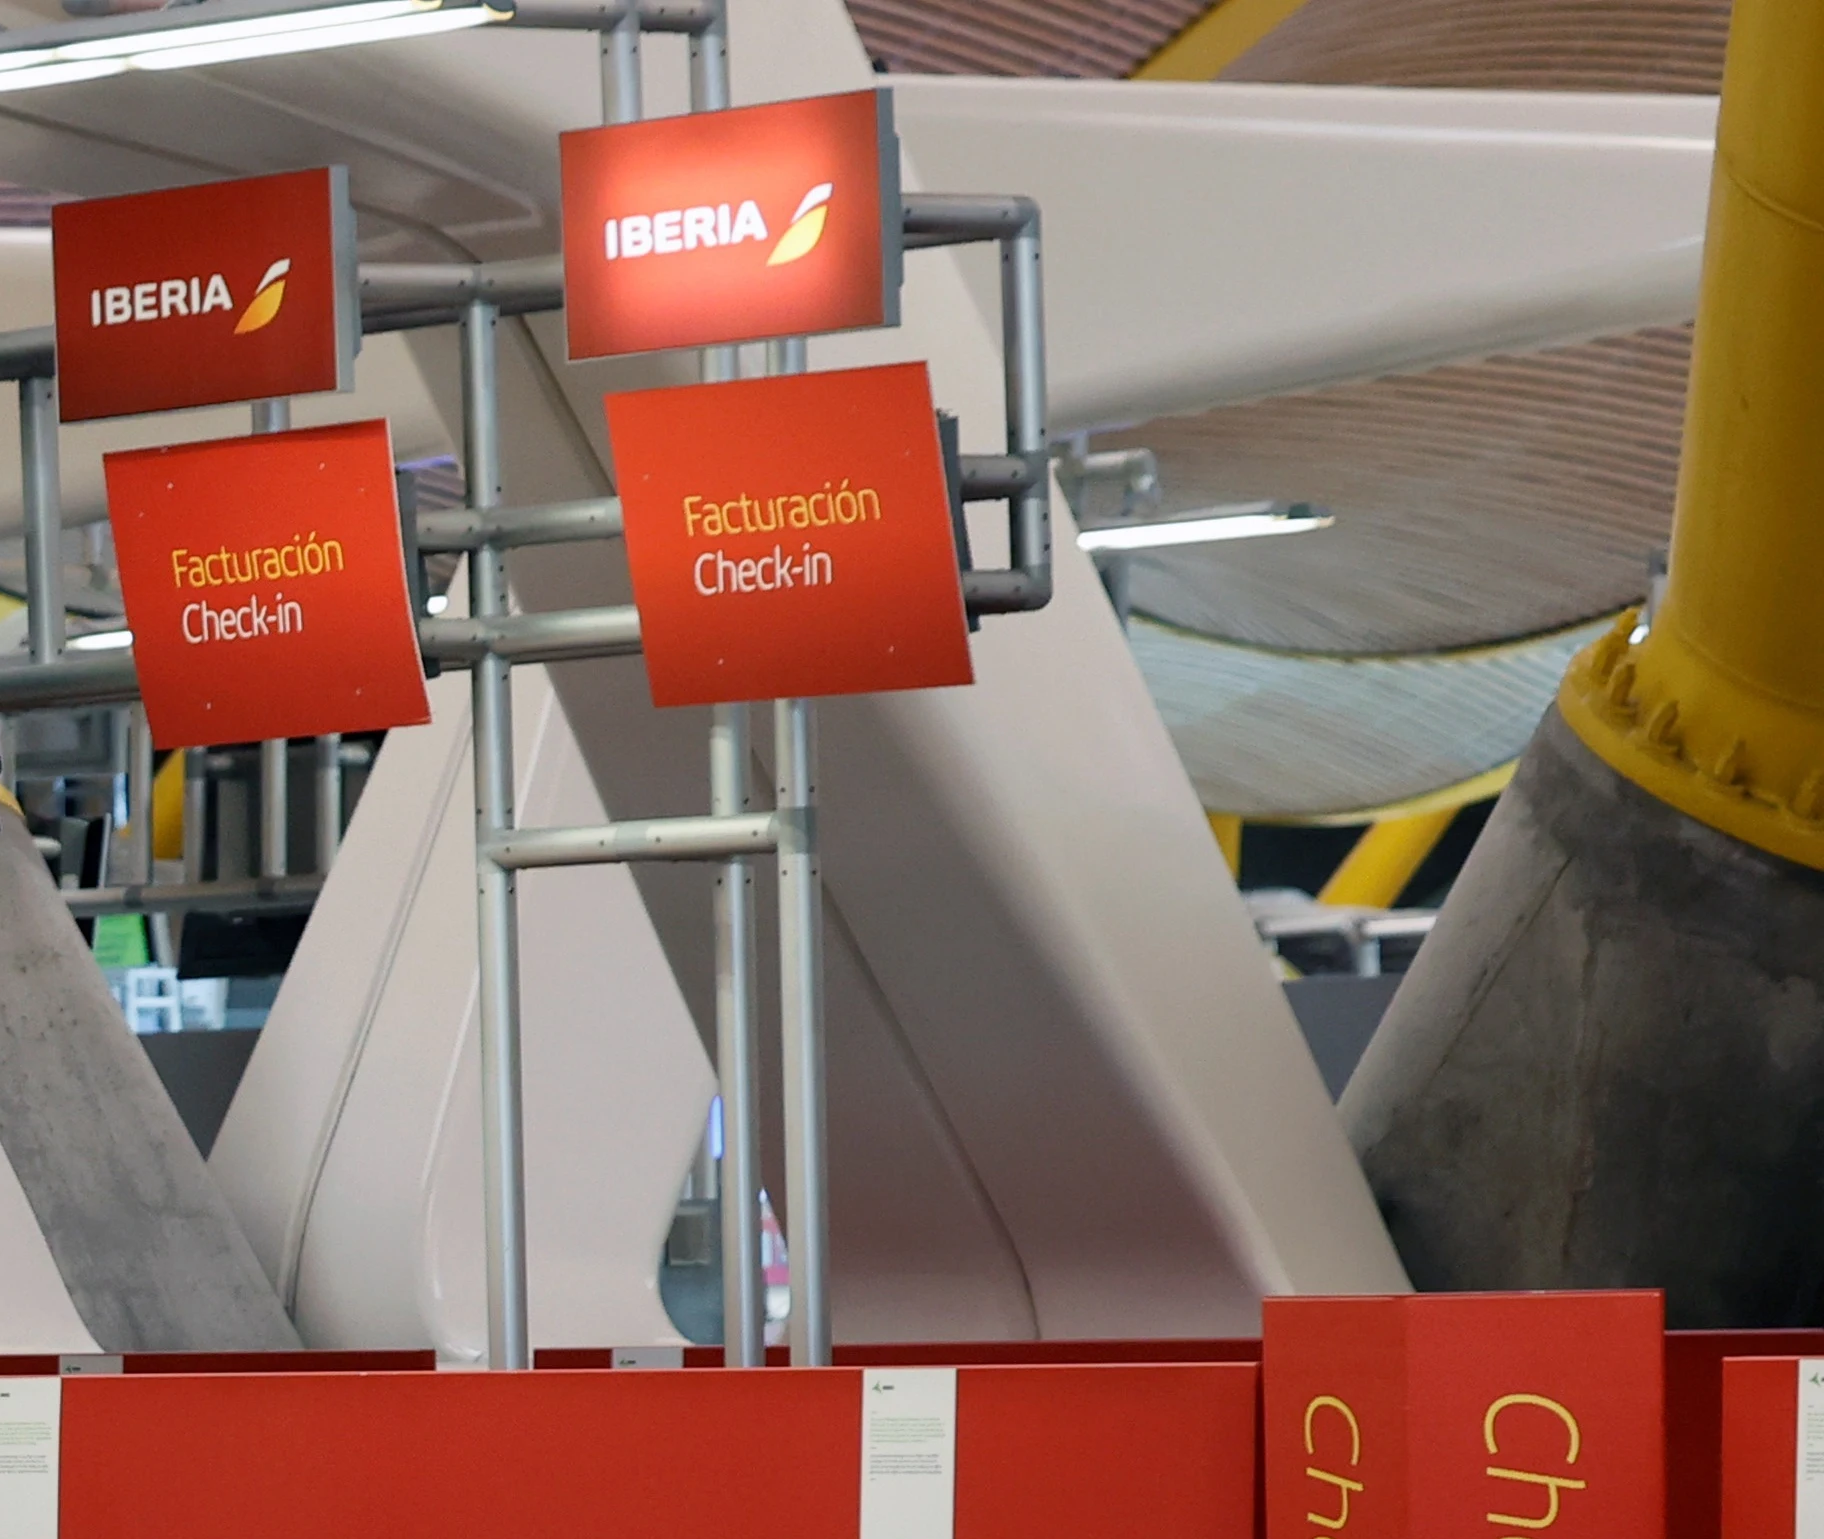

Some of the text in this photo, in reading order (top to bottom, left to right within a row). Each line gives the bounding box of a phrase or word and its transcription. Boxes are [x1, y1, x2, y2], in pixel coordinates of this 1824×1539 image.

[604, 199, 768, 262] IBERIA
[90, 272, 233, 328] IBERIA
[682, 477, 881, 539] Facturación
[171, 531, 344, 589] Facturación
[693, 542, 833, 598] Check-in
[181, 592, 303, 645] Check-in
